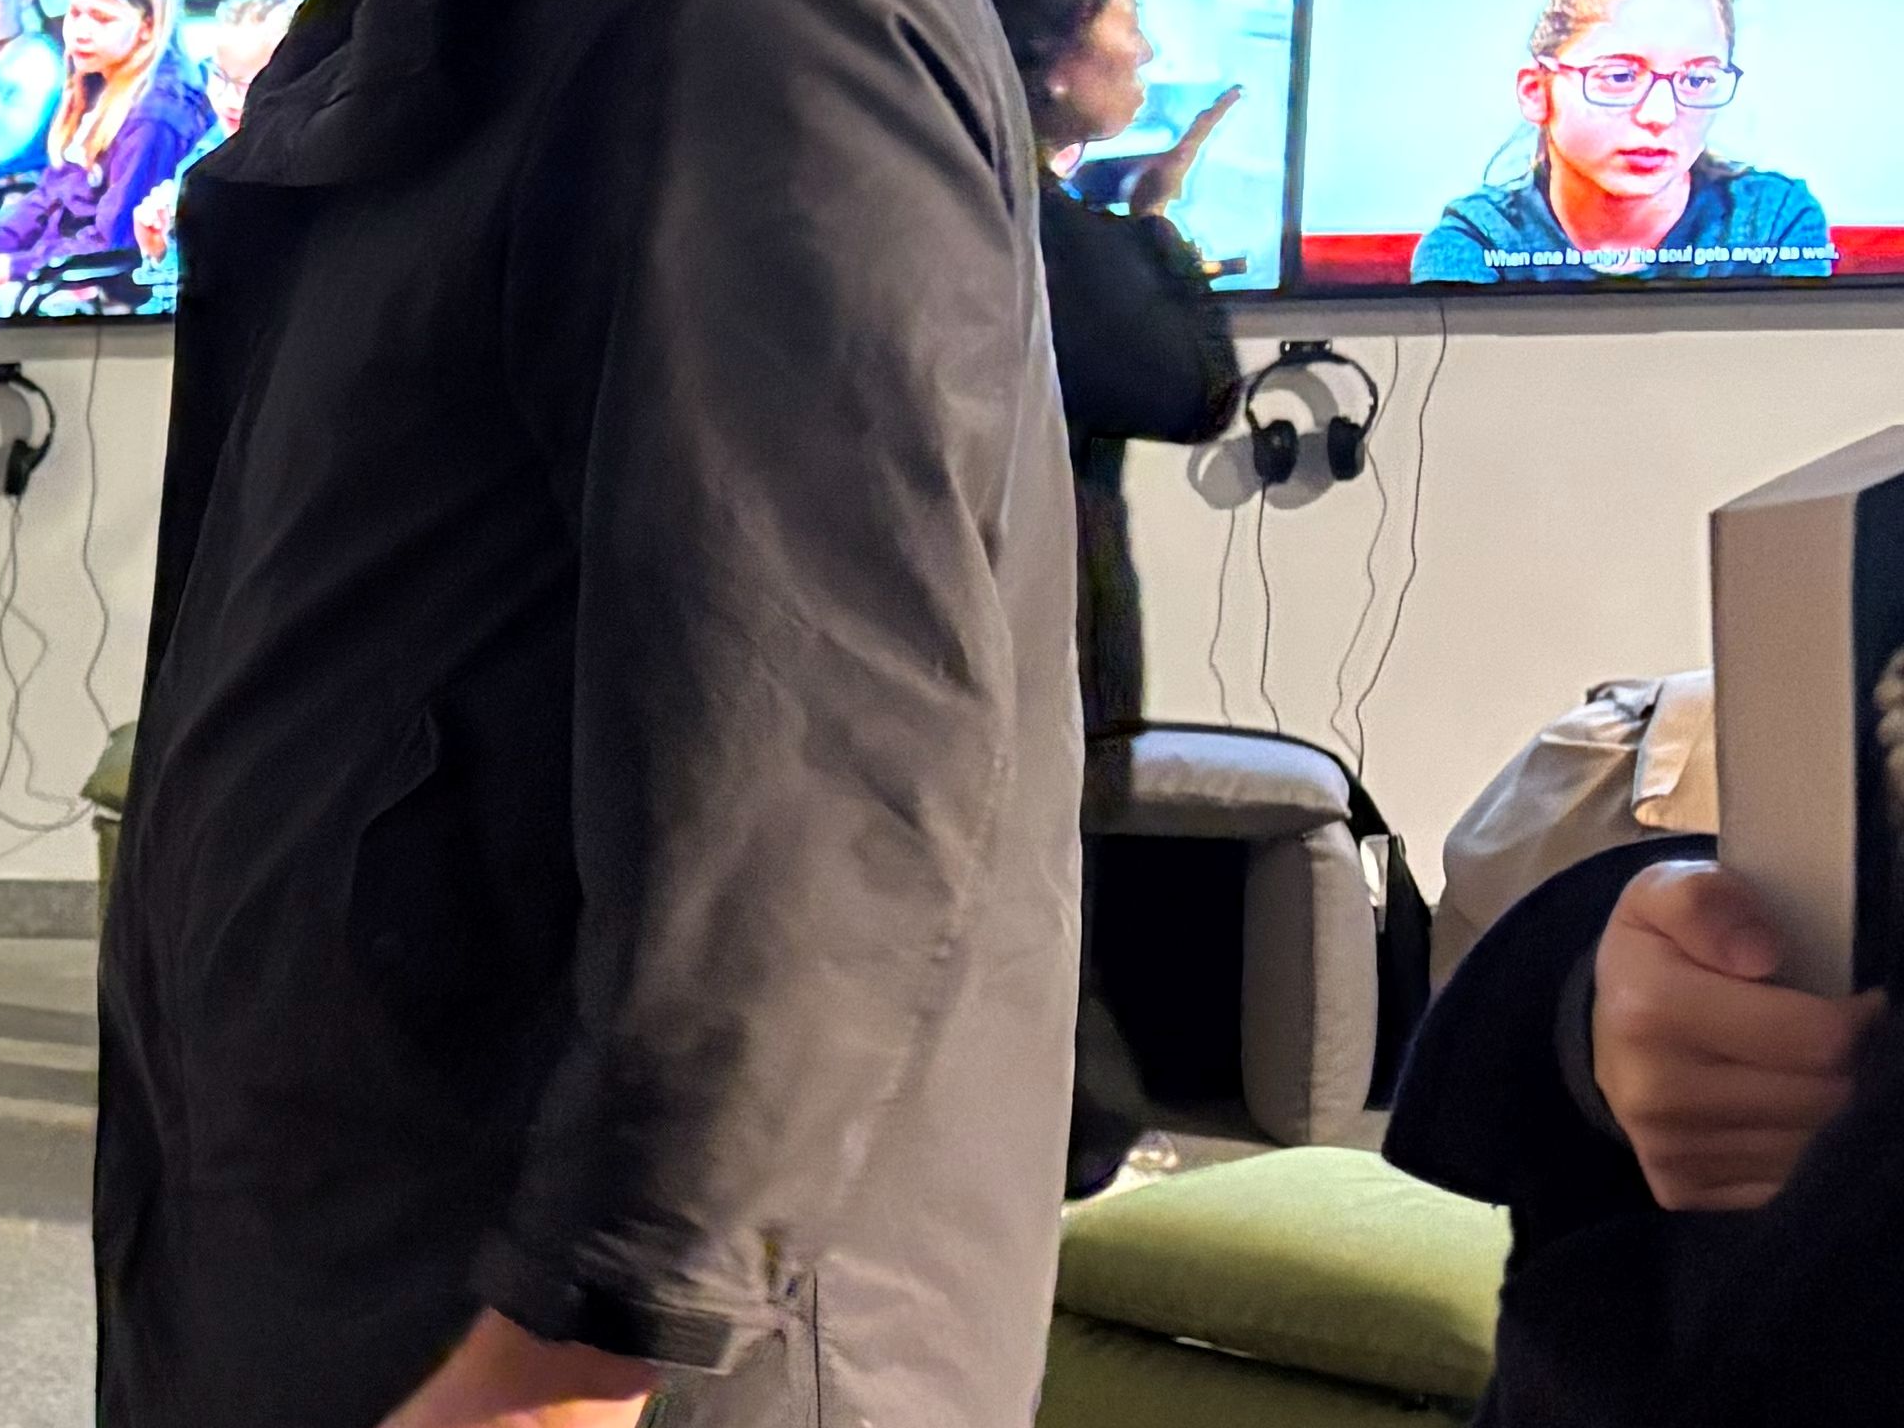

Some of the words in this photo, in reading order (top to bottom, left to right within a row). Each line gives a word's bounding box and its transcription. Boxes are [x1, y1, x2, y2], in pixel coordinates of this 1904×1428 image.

[1483, 249, 1531, 267] When
[1532, 250, 1564, 266] one
[1565, 247, 1581, 265] is
[1630, 247, 1657, 264] the
[1658, 245, 1693, 263] soul
[1694, 245, 1730, 266] gets
[1731, 246, 1778, 264] angry
[1779, 246, 1800, 260] as
[1802, 243, 1840, 260] well.
